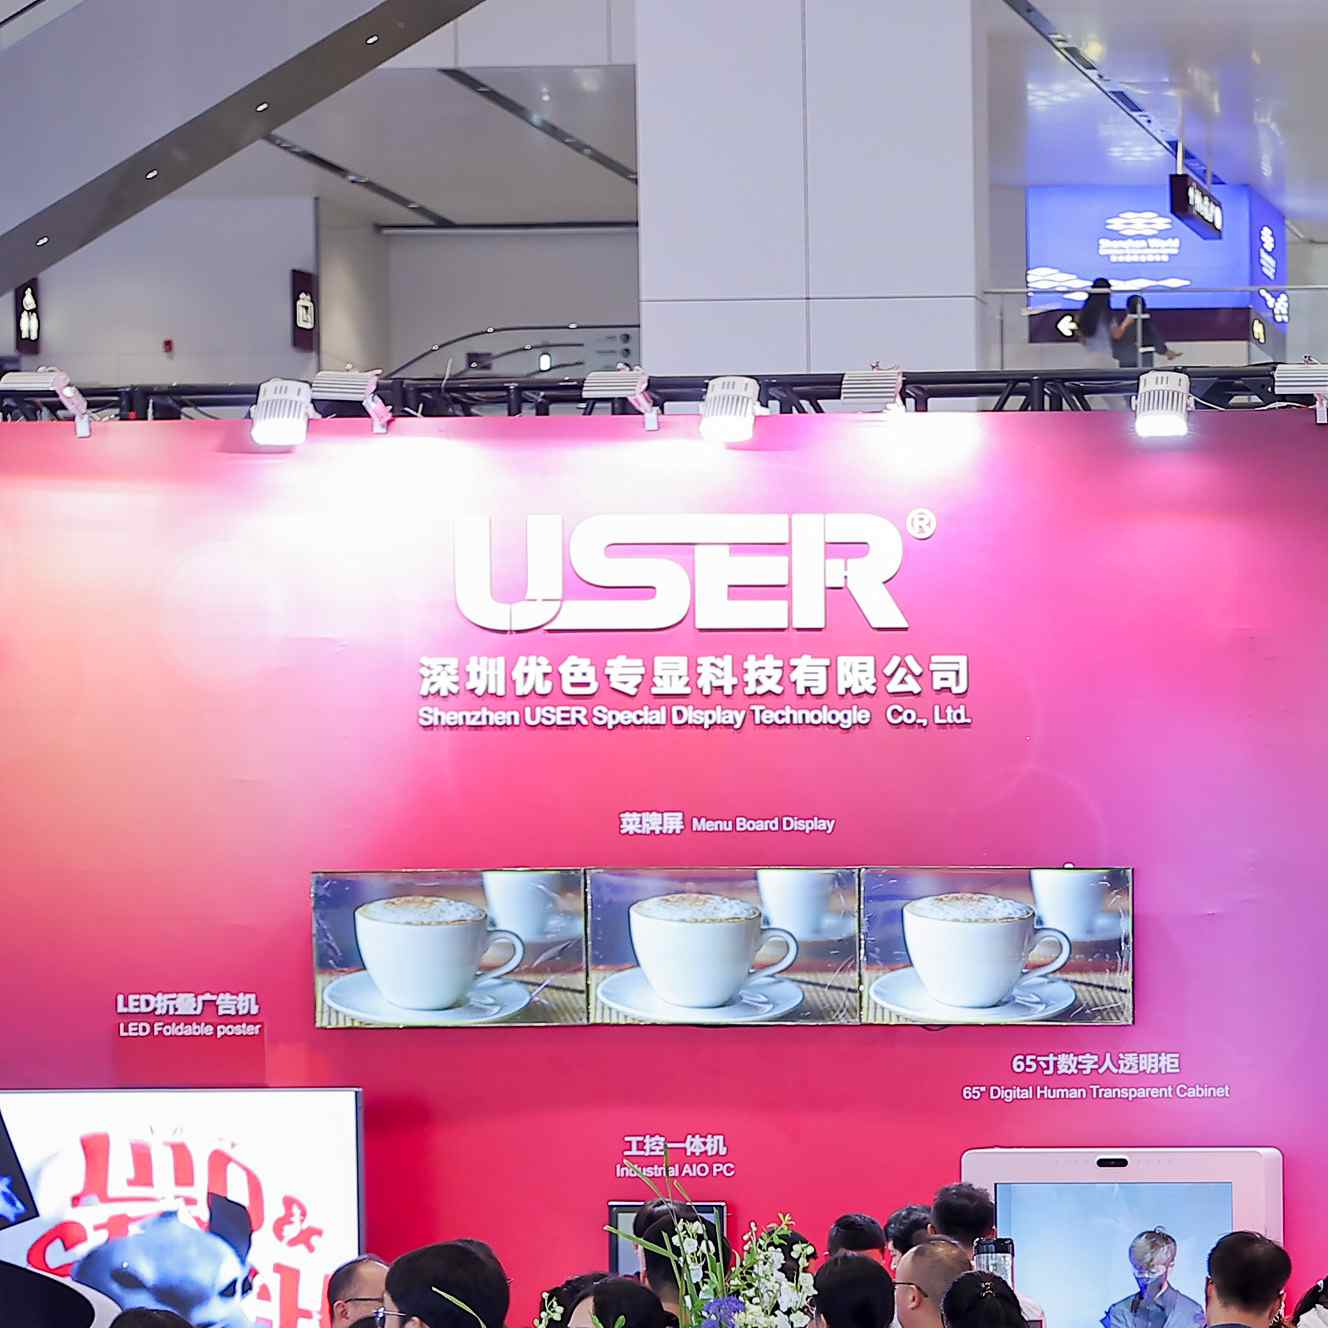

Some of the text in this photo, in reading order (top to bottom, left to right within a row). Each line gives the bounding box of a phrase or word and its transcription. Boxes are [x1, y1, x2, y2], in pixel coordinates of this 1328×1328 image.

[452, 513, 909, 634] USER
[418, 655, 971, 697] 深圳优色专显科技有限公司
[418, 706, 521, 728] Shenzhen
[525, 706, 588, 727] USER
[592, 705, 667, 732] Special
[671, 705, 746, 732] Display
[752, 704, 871, 730] Technologie
[933, 704, 972, 726] Ltd.
[619, 812, 685, 835] 菜牌屏
[692, 816, 836, 835] Menu Board Display
[116, 991, 260, 1016] LED折叠广告机
[119, 1021, 261, 1038] LED Foldable poster
[1011, 1053, 1180, 1075] 65寸数字人透明柜
[989, 1085, 1033, 1103] Digital
[1036, 1085, 1087, 1099] Human
[1090, 1084, 1173, 1102] Transparent
[1176, 1084, 1231, 1099] Cabinet
[623, 1134, 728, 1156] 工控一体机
[682, 1163, 709, 1177] AIO
[712, 1163, 736, 1177] PC
